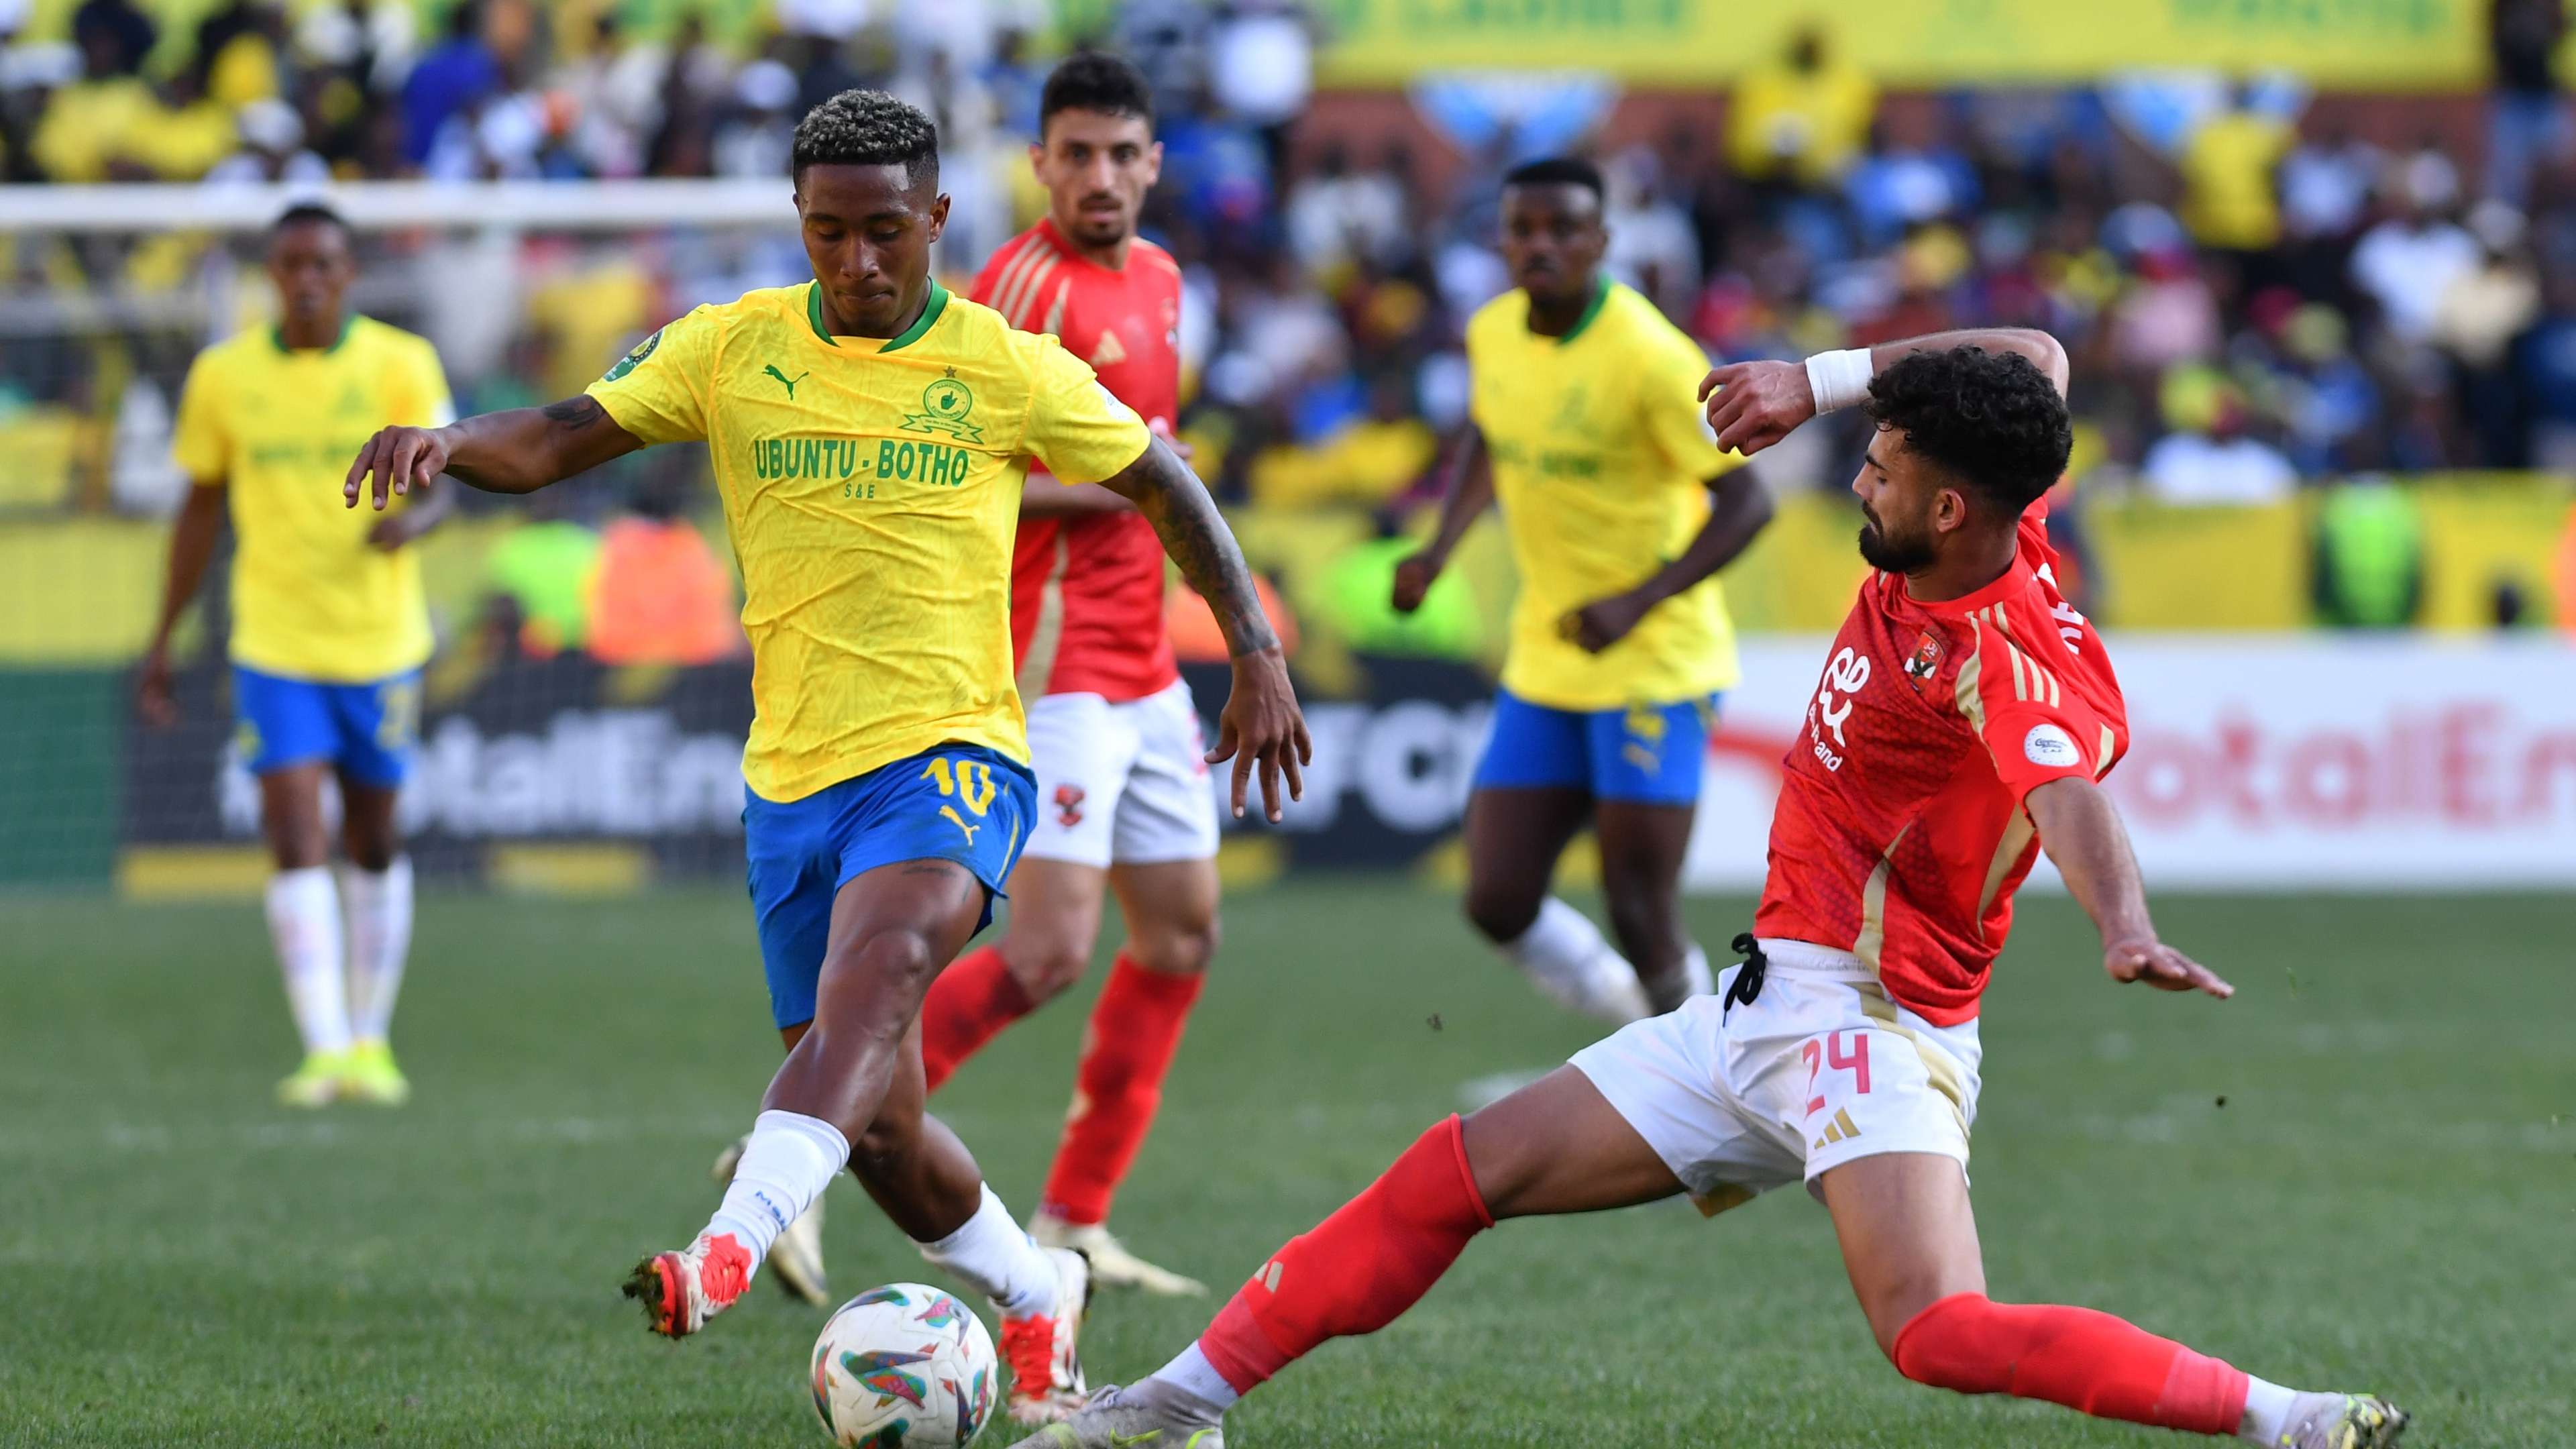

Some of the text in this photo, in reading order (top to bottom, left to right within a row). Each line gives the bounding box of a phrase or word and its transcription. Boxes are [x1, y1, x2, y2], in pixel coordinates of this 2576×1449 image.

[754, 439, 857, 479] UBUNTU
[877, 440, 969, 487] BOTHO
[845, 484, 875, 499] S & E
[1814, 741, 1843, 772] and
[2113, 699, 2576, 830] otalEn
[920, 757, 996, 816] 10
[1803, 1030, 1870, 1117] 24
